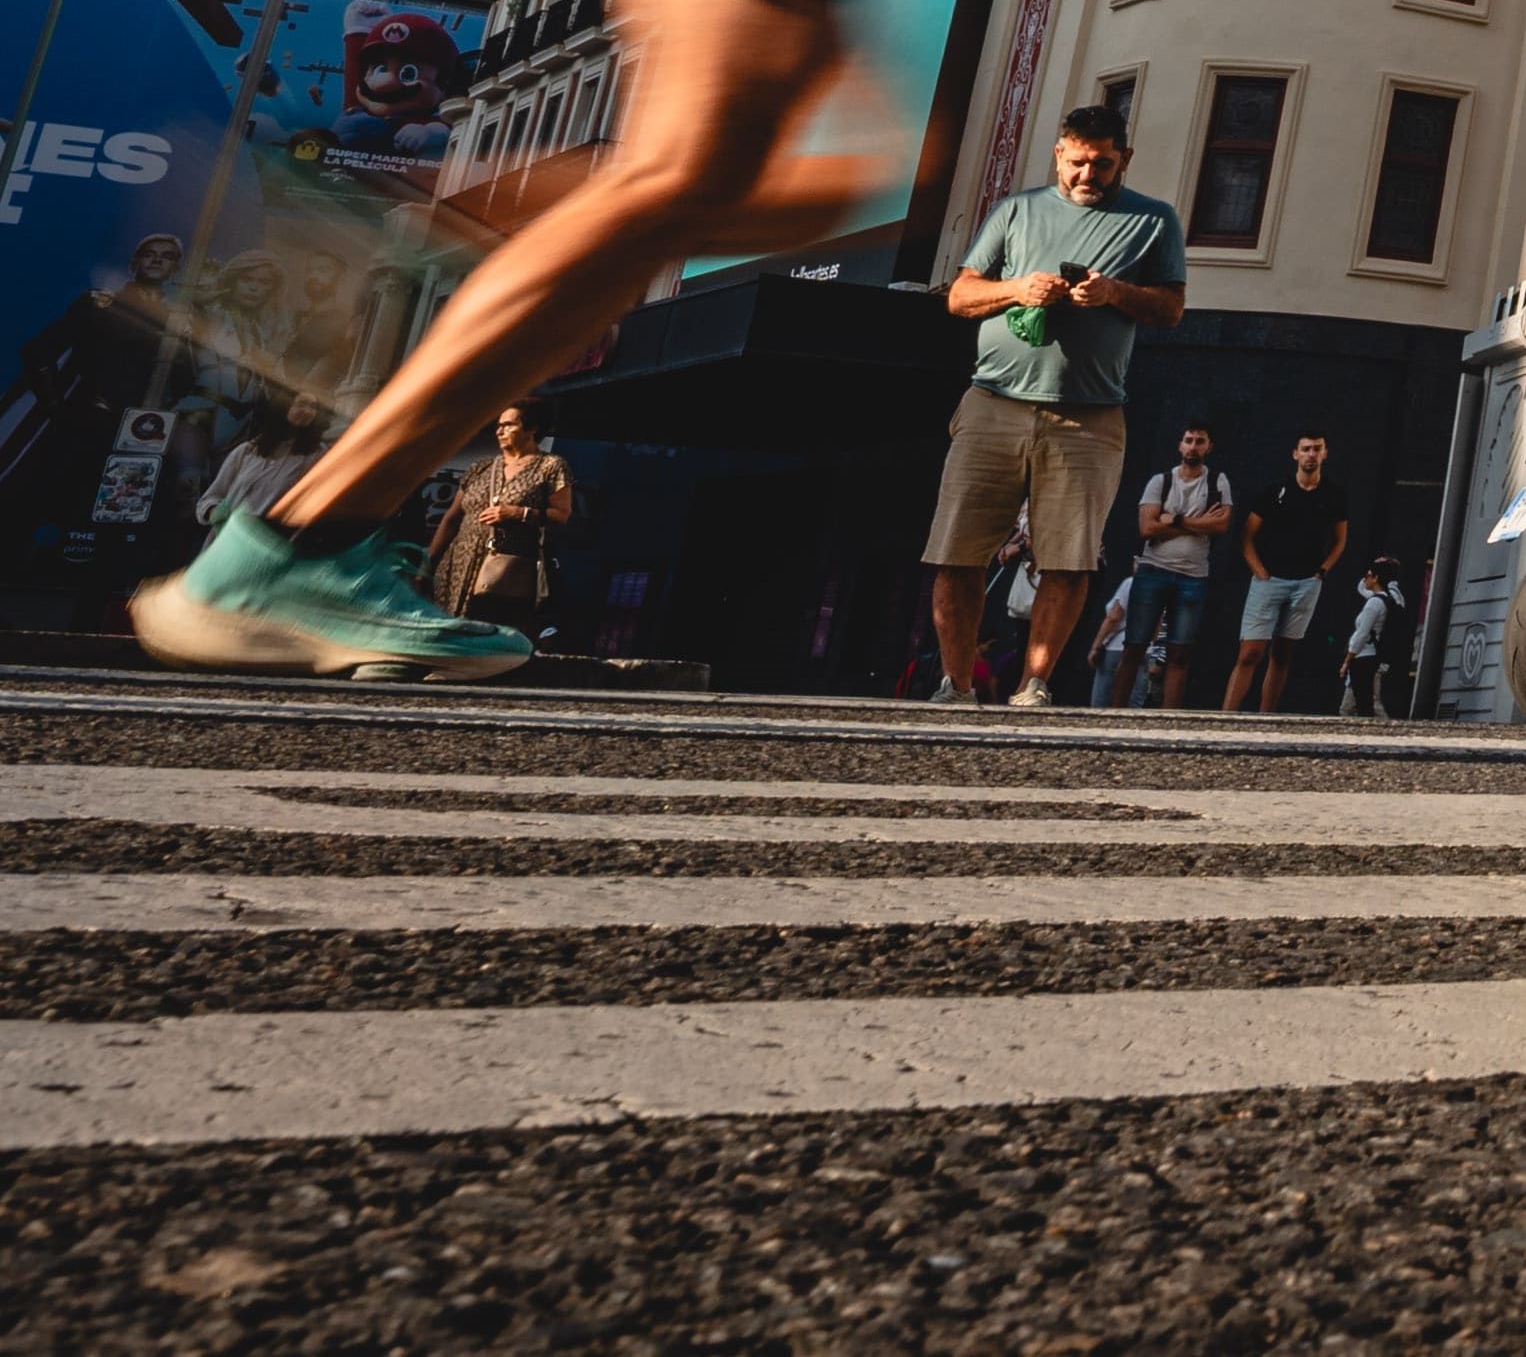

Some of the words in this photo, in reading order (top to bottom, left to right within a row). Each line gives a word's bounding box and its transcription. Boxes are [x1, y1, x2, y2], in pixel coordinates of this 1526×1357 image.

[323, 156, 341, 166] LA
[326, 147, 370, 161] SUPER
[371, 153, 416, 167] MARIO
